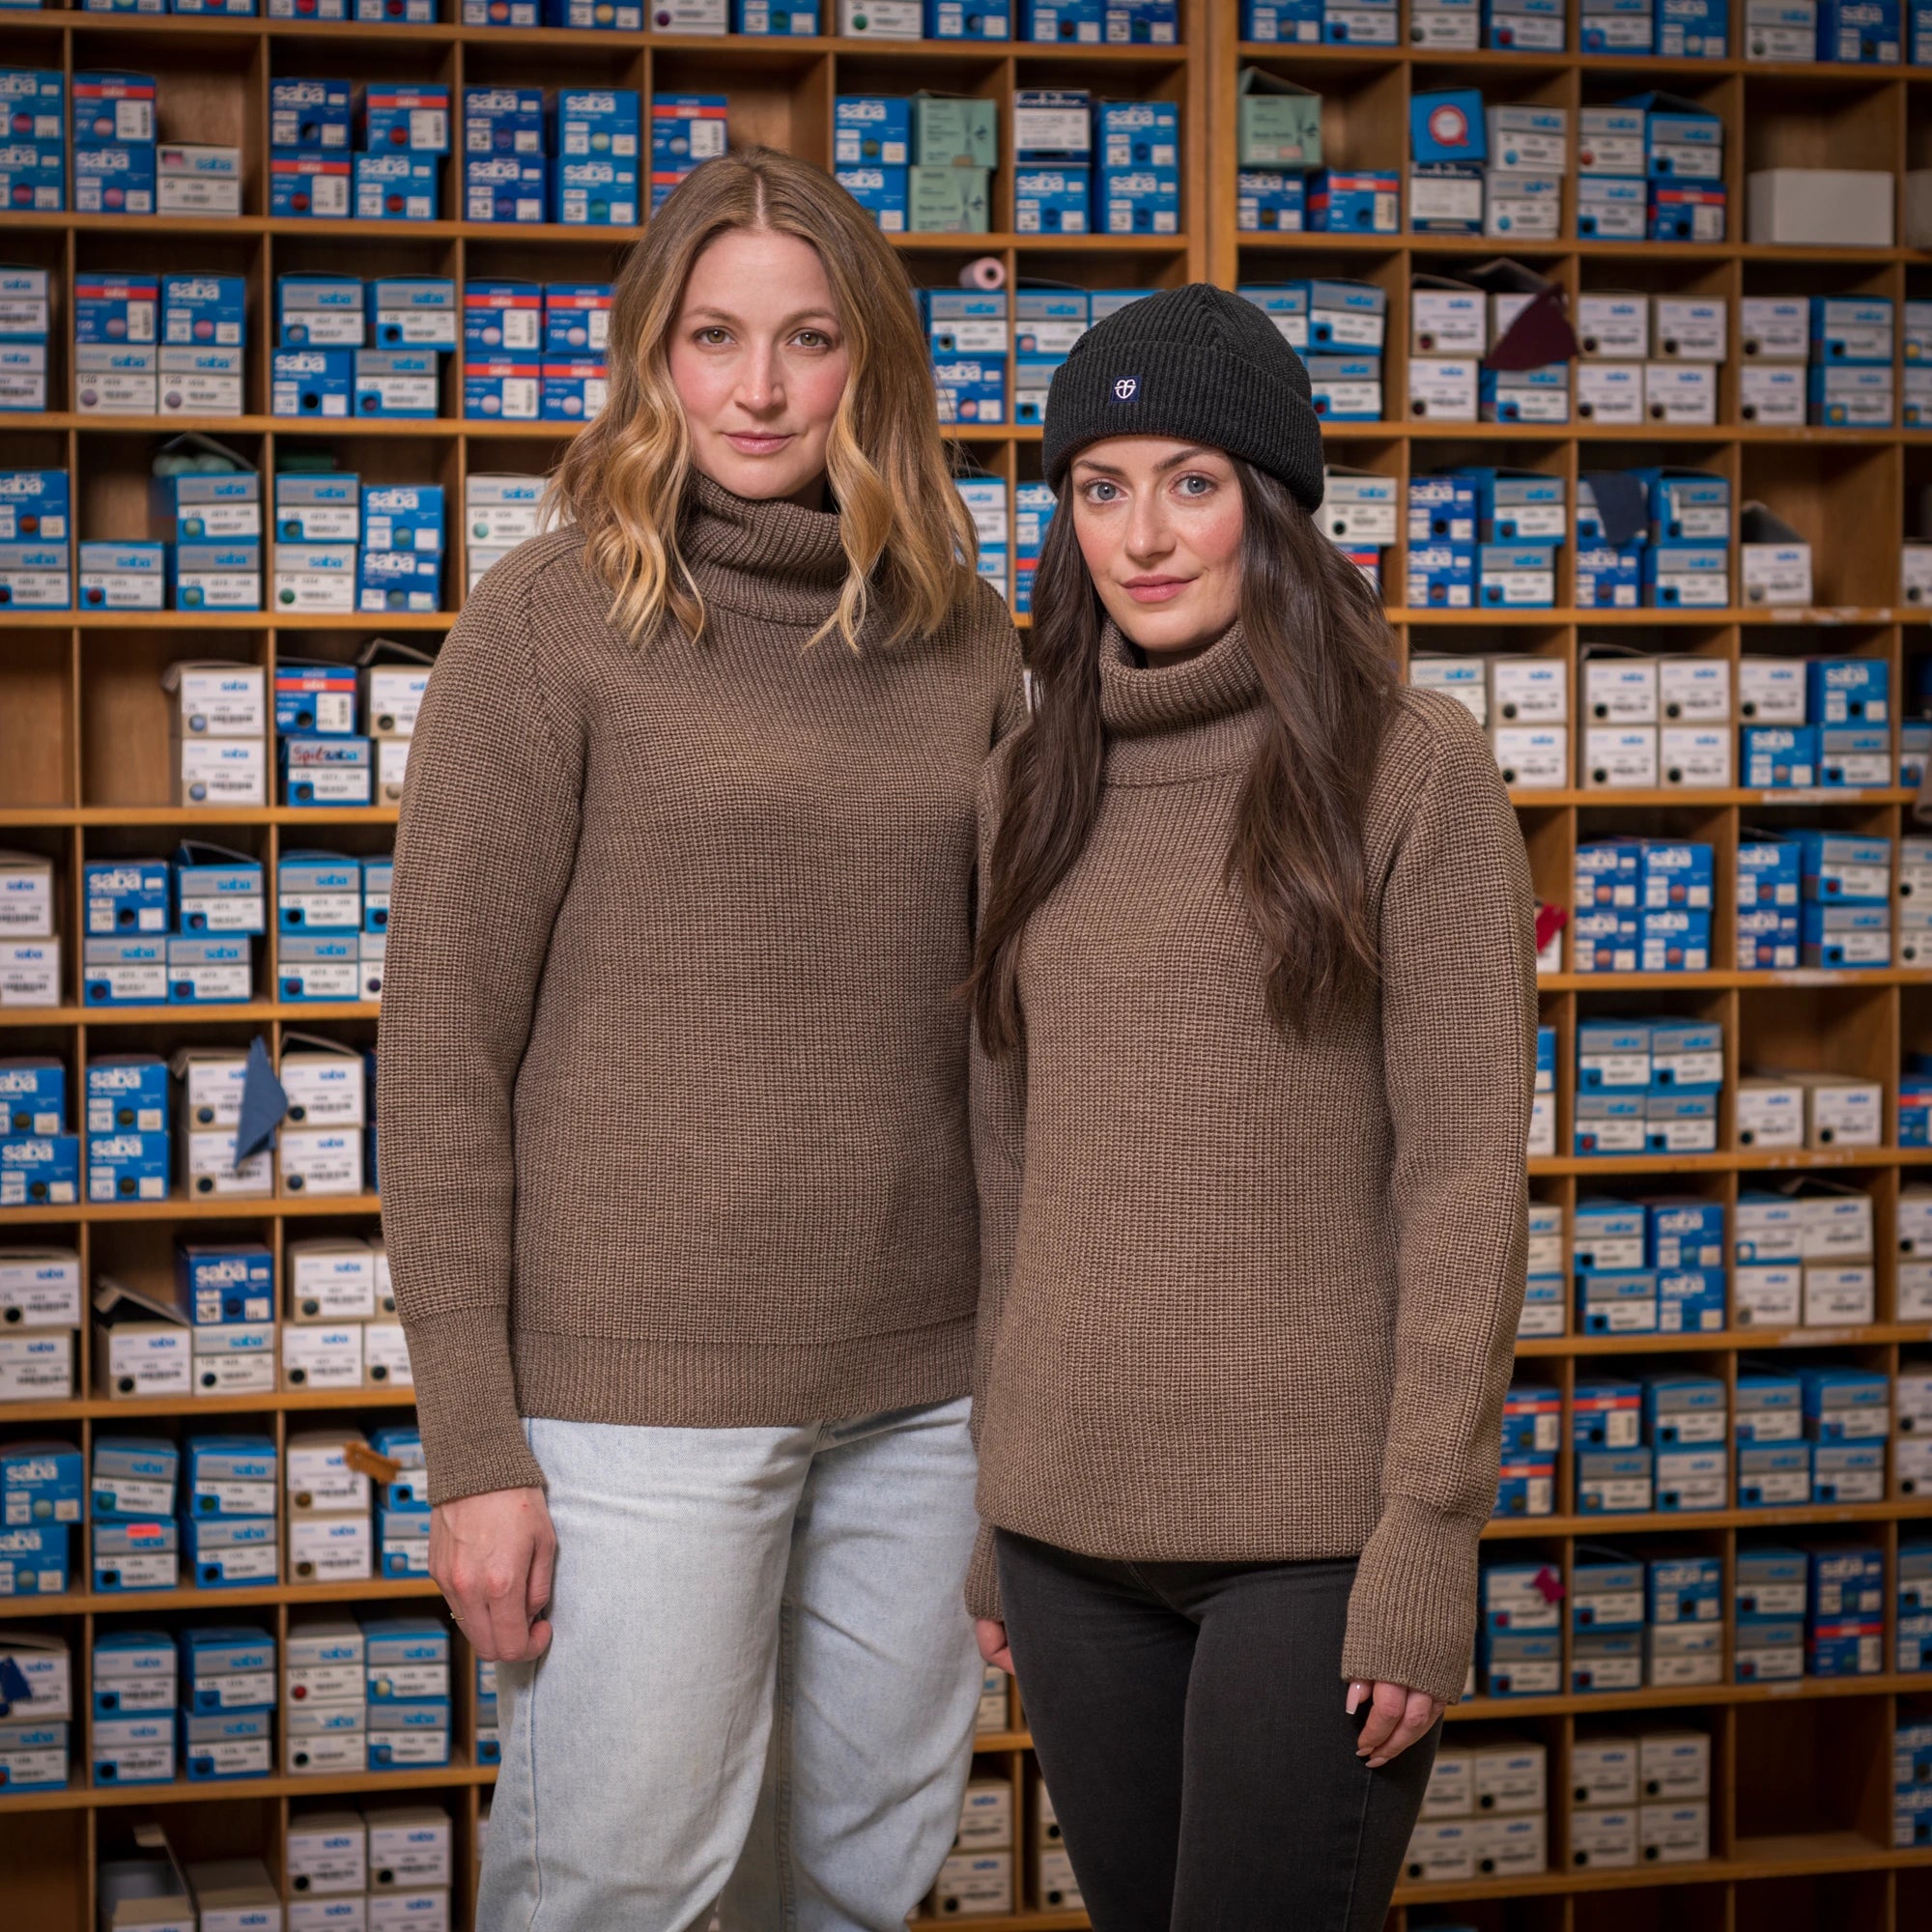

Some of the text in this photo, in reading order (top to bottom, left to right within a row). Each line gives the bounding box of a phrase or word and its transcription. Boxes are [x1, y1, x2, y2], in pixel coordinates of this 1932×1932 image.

[0, 78, 37, 94] aba
[273, 86, 324, 102] saba
[468, 95, 517, 110] saba
[0, 150, 37, 166] aba
[77, 152, 128, 169] saba
[359, 159, 410, 176] saba
[469, 162, 520, 179] saba
[168, 281, 219, 299] saba
[275, 355, 326, 372] saba
[368, 490, 418, 508] saba
[364, 553, 415, 573] saba
[89, 873, 141, 891] saba
[0, 1076, 37, 1092] aba
[91, 1070, 141, 1089] saba
[3, 1145, 52, 1160] saba
[92, 1139, 142, 1155] saba
[196, 1264, 246, 1283] saba
[7, 1463, 56, 1482] saba
